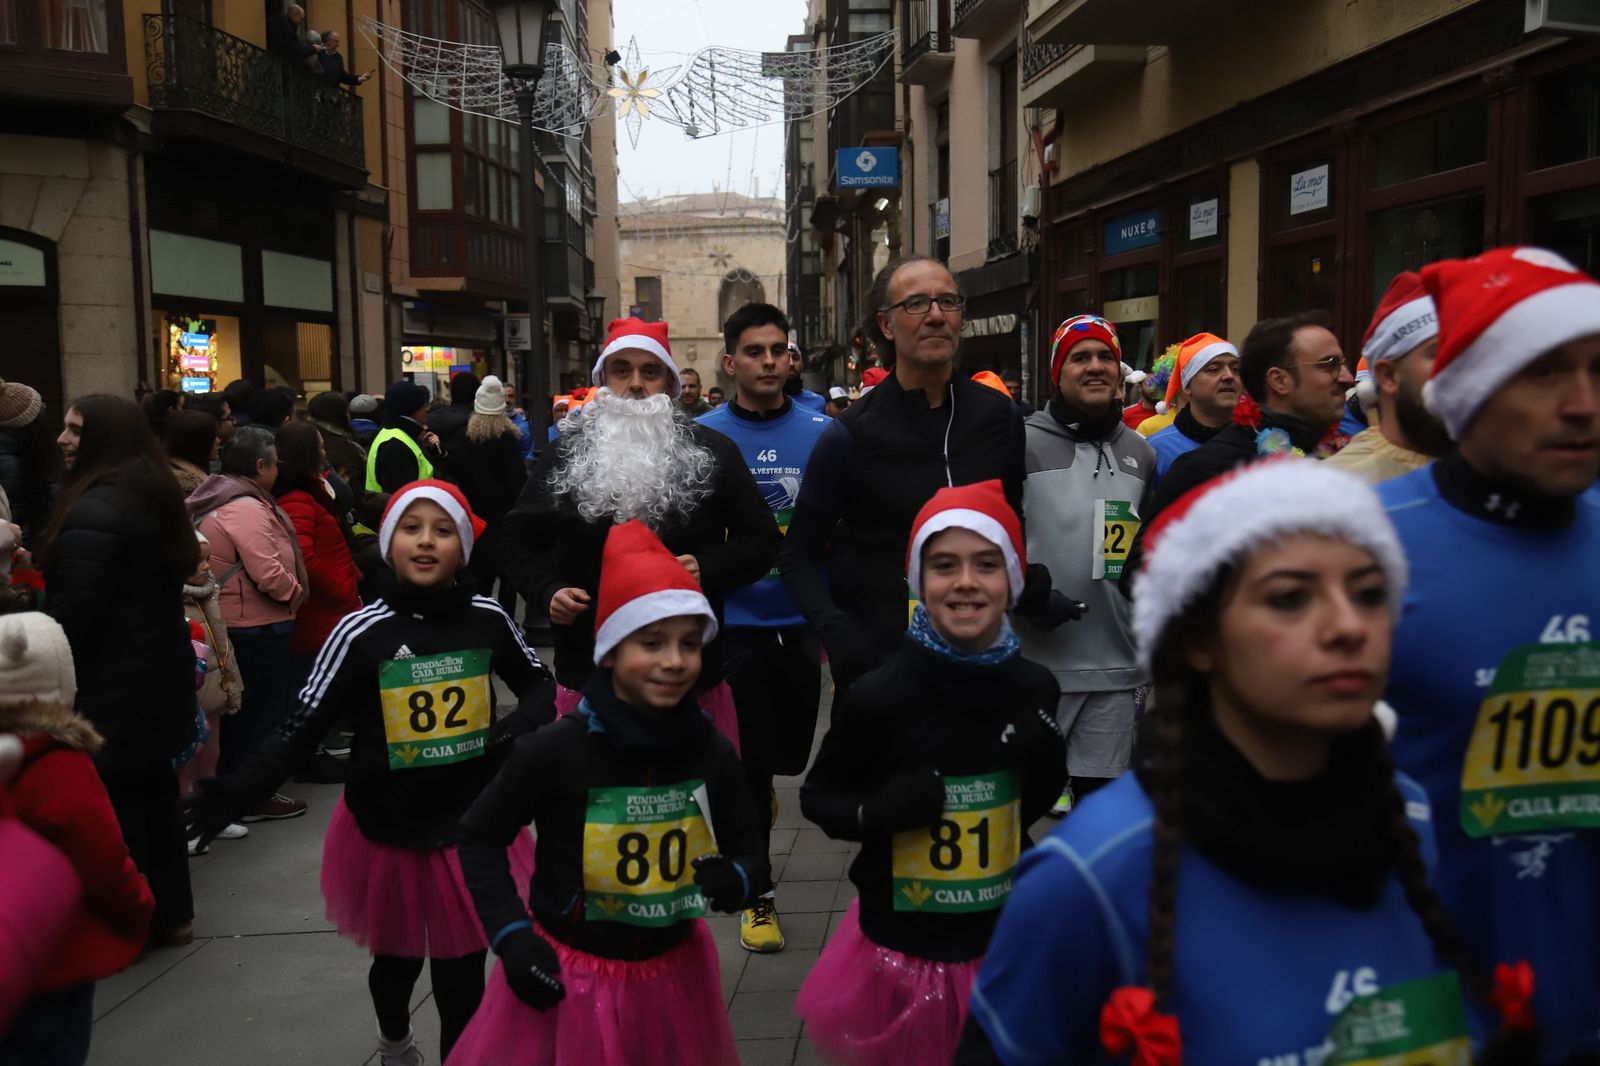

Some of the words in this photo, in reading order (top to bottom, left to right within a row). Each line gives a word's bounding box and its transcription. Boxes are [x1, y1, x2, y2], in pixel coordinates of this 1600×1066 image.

[841, 176, 893, 185] Samsonite
[1294, 176, 1306, 191] La
[1308, 175, 1325, 188] mer
[1121, 222, 1146, 240] NUXE
[757, 449, 777, 462] 46
[1539, 614, 1591, 644] 46
[412, 668, 434, 679] CAJA
[436, 665, 464, 675] RURAL
[408, 686, 468, 733] 82
[1489, 698, 1600, 772] 1109
[422, 745, 455, 758] CAJA
[961, 791, 996, 803] RURAL
[627, 805, 654, 815] CAJA
[657, 801, 688, 814] RURAL
[929, 817, 989, 871] 81
[616, 829, 687, 886] 80
[935, 889, 974, 903] CAJA
[628, 903, 667, 918] CAJA
